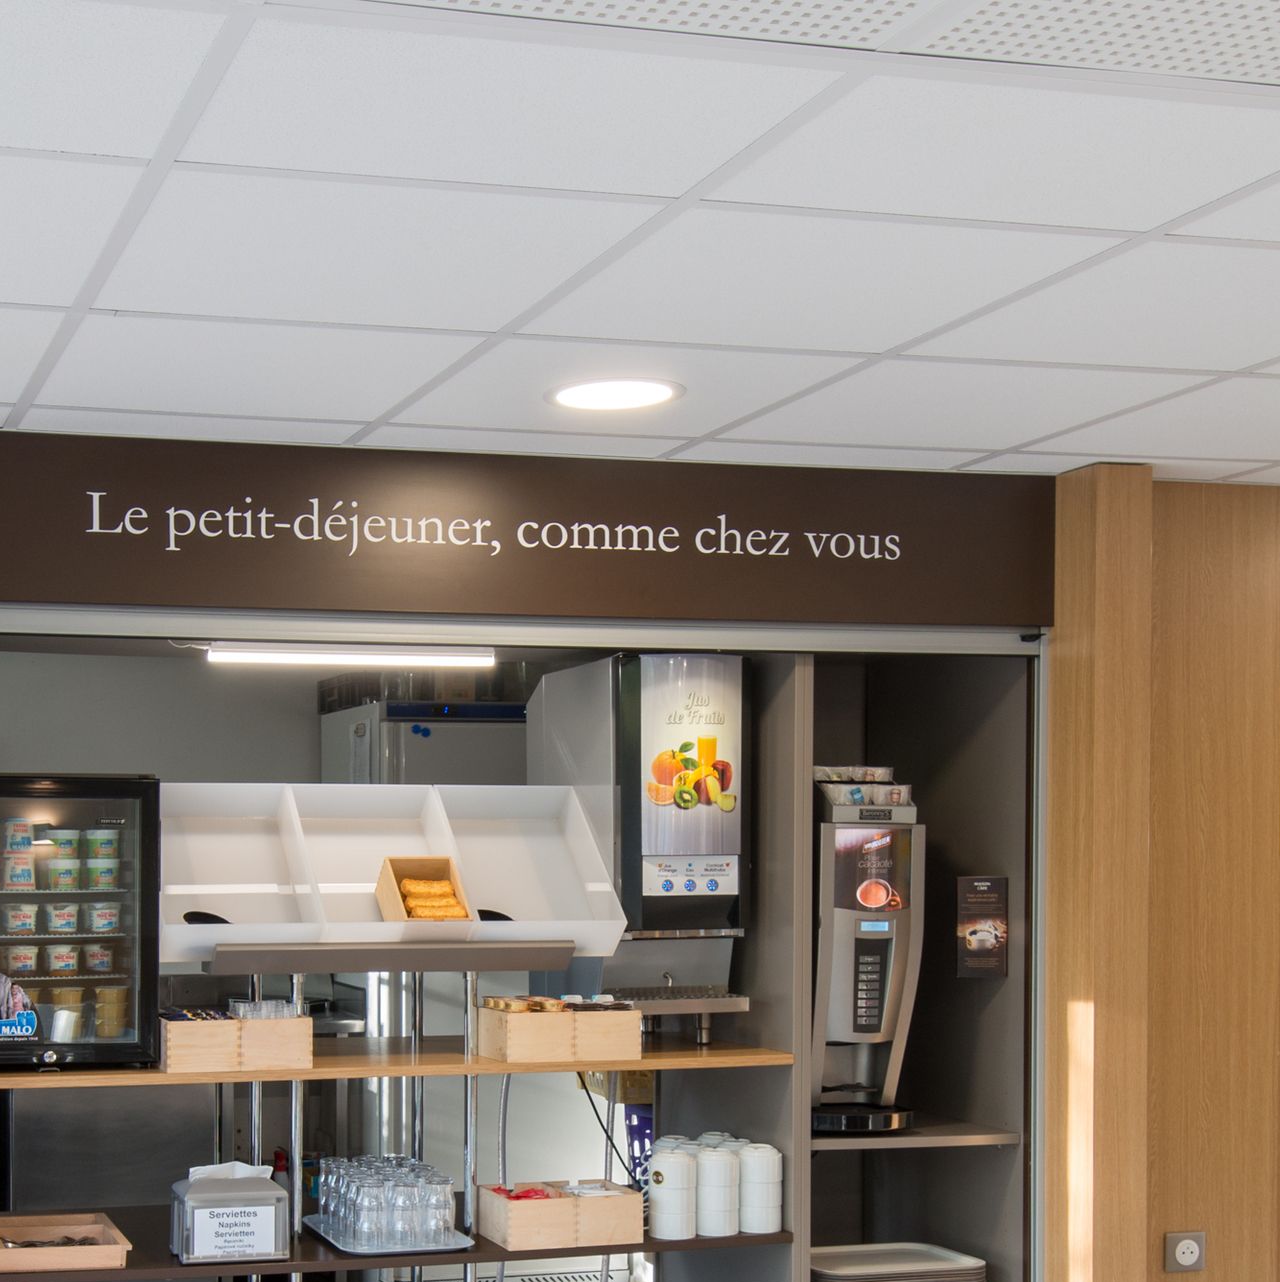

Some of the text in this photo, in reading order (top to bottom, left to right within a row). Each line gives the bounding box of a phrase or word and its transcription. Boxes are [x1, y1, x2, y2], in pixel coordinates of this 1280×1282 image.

[85, 491, 901, 561] Le petit-déjeuner, comme chez vous
[1, 1024, 32, 1036] MALO
[208, 1210, 257, 1219] Serviettes
[218, 1221, 250, 1229] Napkins
